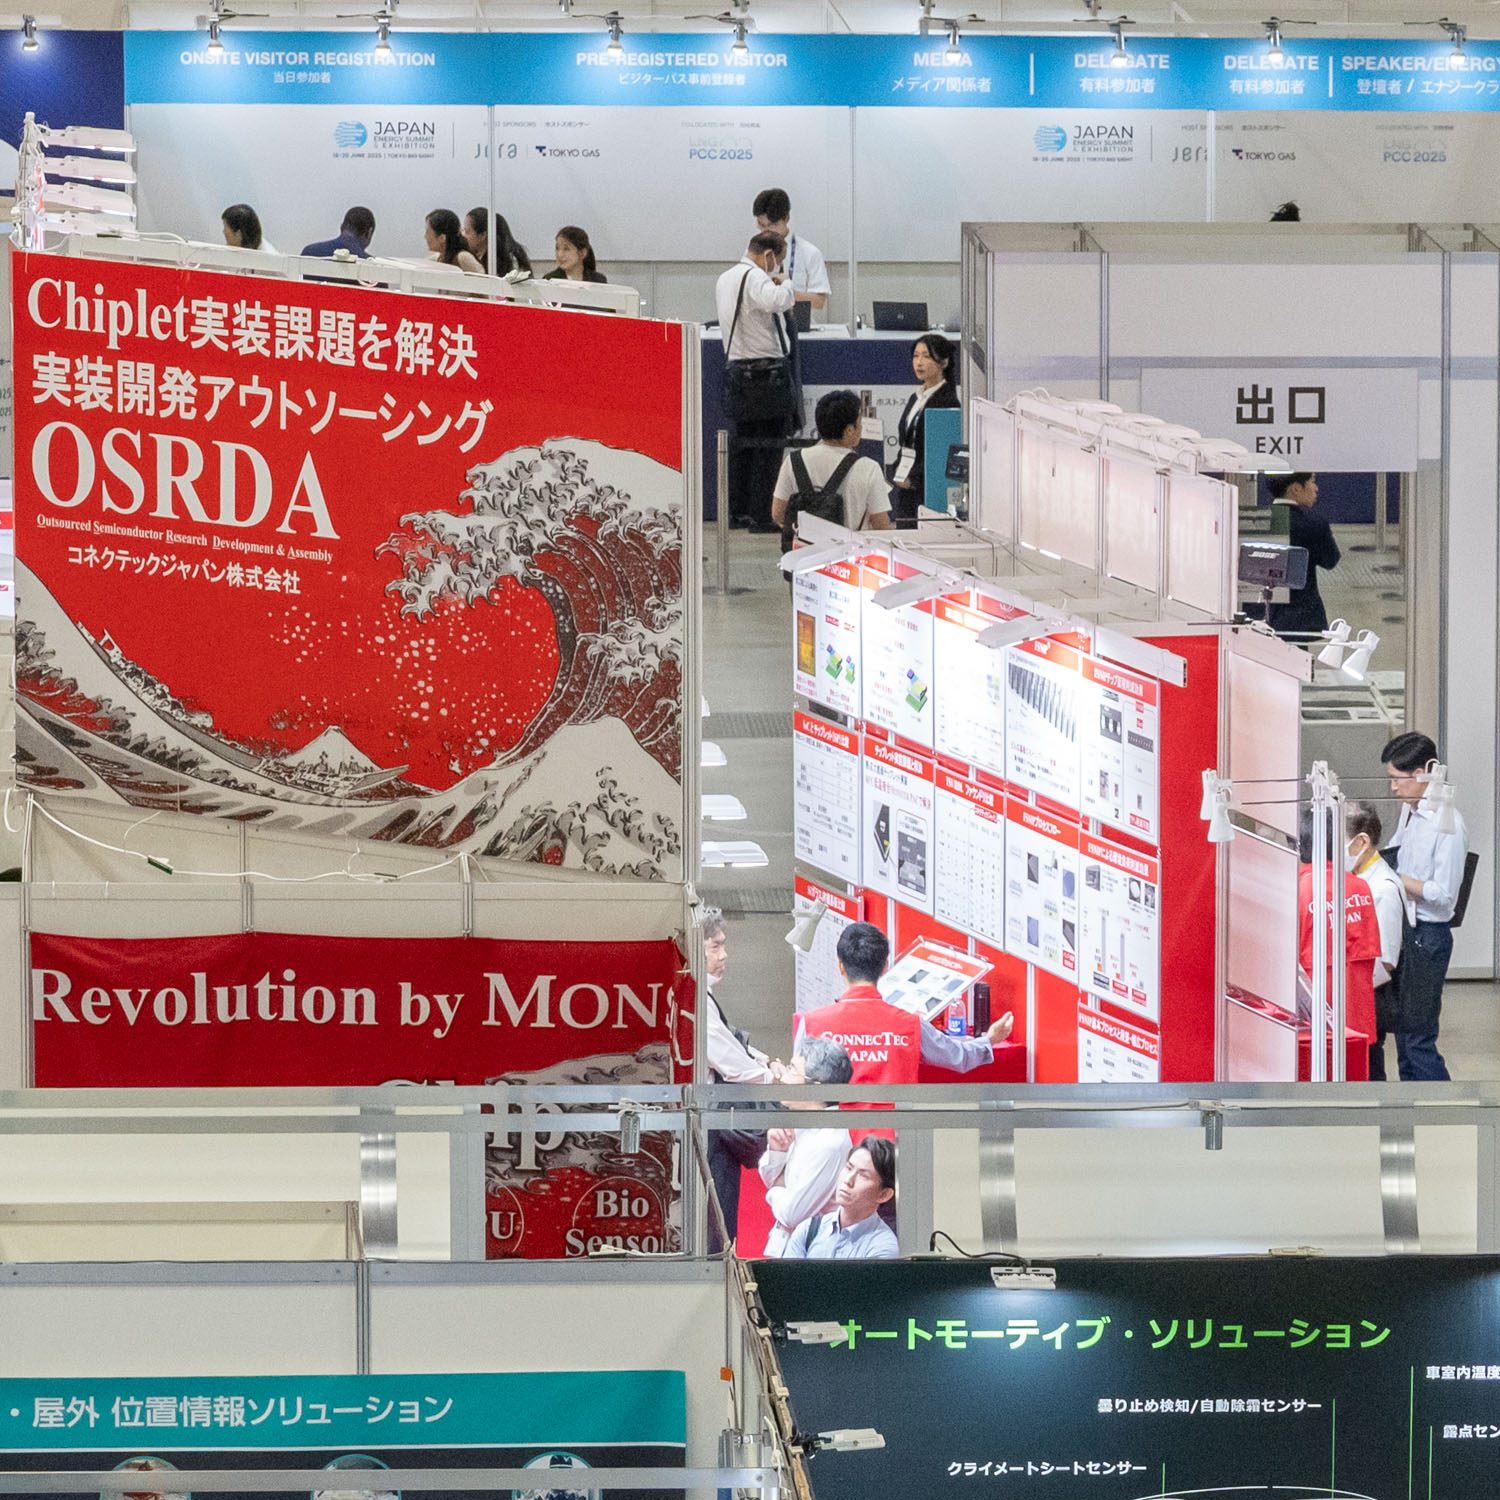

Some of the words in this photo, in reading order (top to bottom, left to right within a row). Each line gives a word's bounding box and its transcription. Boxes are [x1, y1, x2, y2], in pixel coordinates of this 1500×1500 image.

[180, 51, 241, 67] ONSITE
[245, 51, 309, 67] VISITOR
[312, 51, 436, 67] REGISTRATION
[576, 51, 718, 68] PRE-REGISTERED
[723, 52, 788, 68] VISITOR
[273, 71, 331, 84] 当日参加者
[892, 78, 991, 92] メディア関係者
[1079, 77, 1155, 93] 有料参加者
[1229, 77, 1305, 93] 有料参加者
[1357, 79, 1400, 95] 登壇者
[374, 122, 435, 135] JAPAN
[1073, 126, 1133, 138] JAPAN
[549, 149, 579, 157] TOKYO
[582, 149, 600, 157] GAS
[689, 149, 717, 160] PCC
[719, 149, 753, 160] 2025
[1245, 151, 1275, 160] TOKYO
[1278, 152, 1296, 160] GAS
[1384, 152, 1410, 162] PCC
[1413, 152, 1446, 162] 2025
[27, 277, 478, 380] Chiplet実装課題を解決
[32, 351, 494, 453] 実装開発アウトソーシング
[1236, 383, 1326, 425] 出口
[1256, 436, 1304, 455] EXIT
[31, 421, 340, 539] OSRDA
[36, 513, 91, 532] Outsourced
[93, 520, 164, 542] Semiconductor
[165, 528, 208, 547] Research
[212, 535, 273, 557] Development
[287, 544, 334, 564] Assembly
[67, 545, 300, 594] コネクテックジャパン株式会社
[32, 970, 378, 1027] Revolution
[399, 982, 464, 1039] by
[595, 1190, 649, 1218] Bio
[111, 1395, 454, 1428] 位置情報ソリューション
[1098, 1397, 1321, 1414] 曇り止め検知/自動除霜センサー
[947, 1460, 1147, 1476] クライメートシートセンサー
